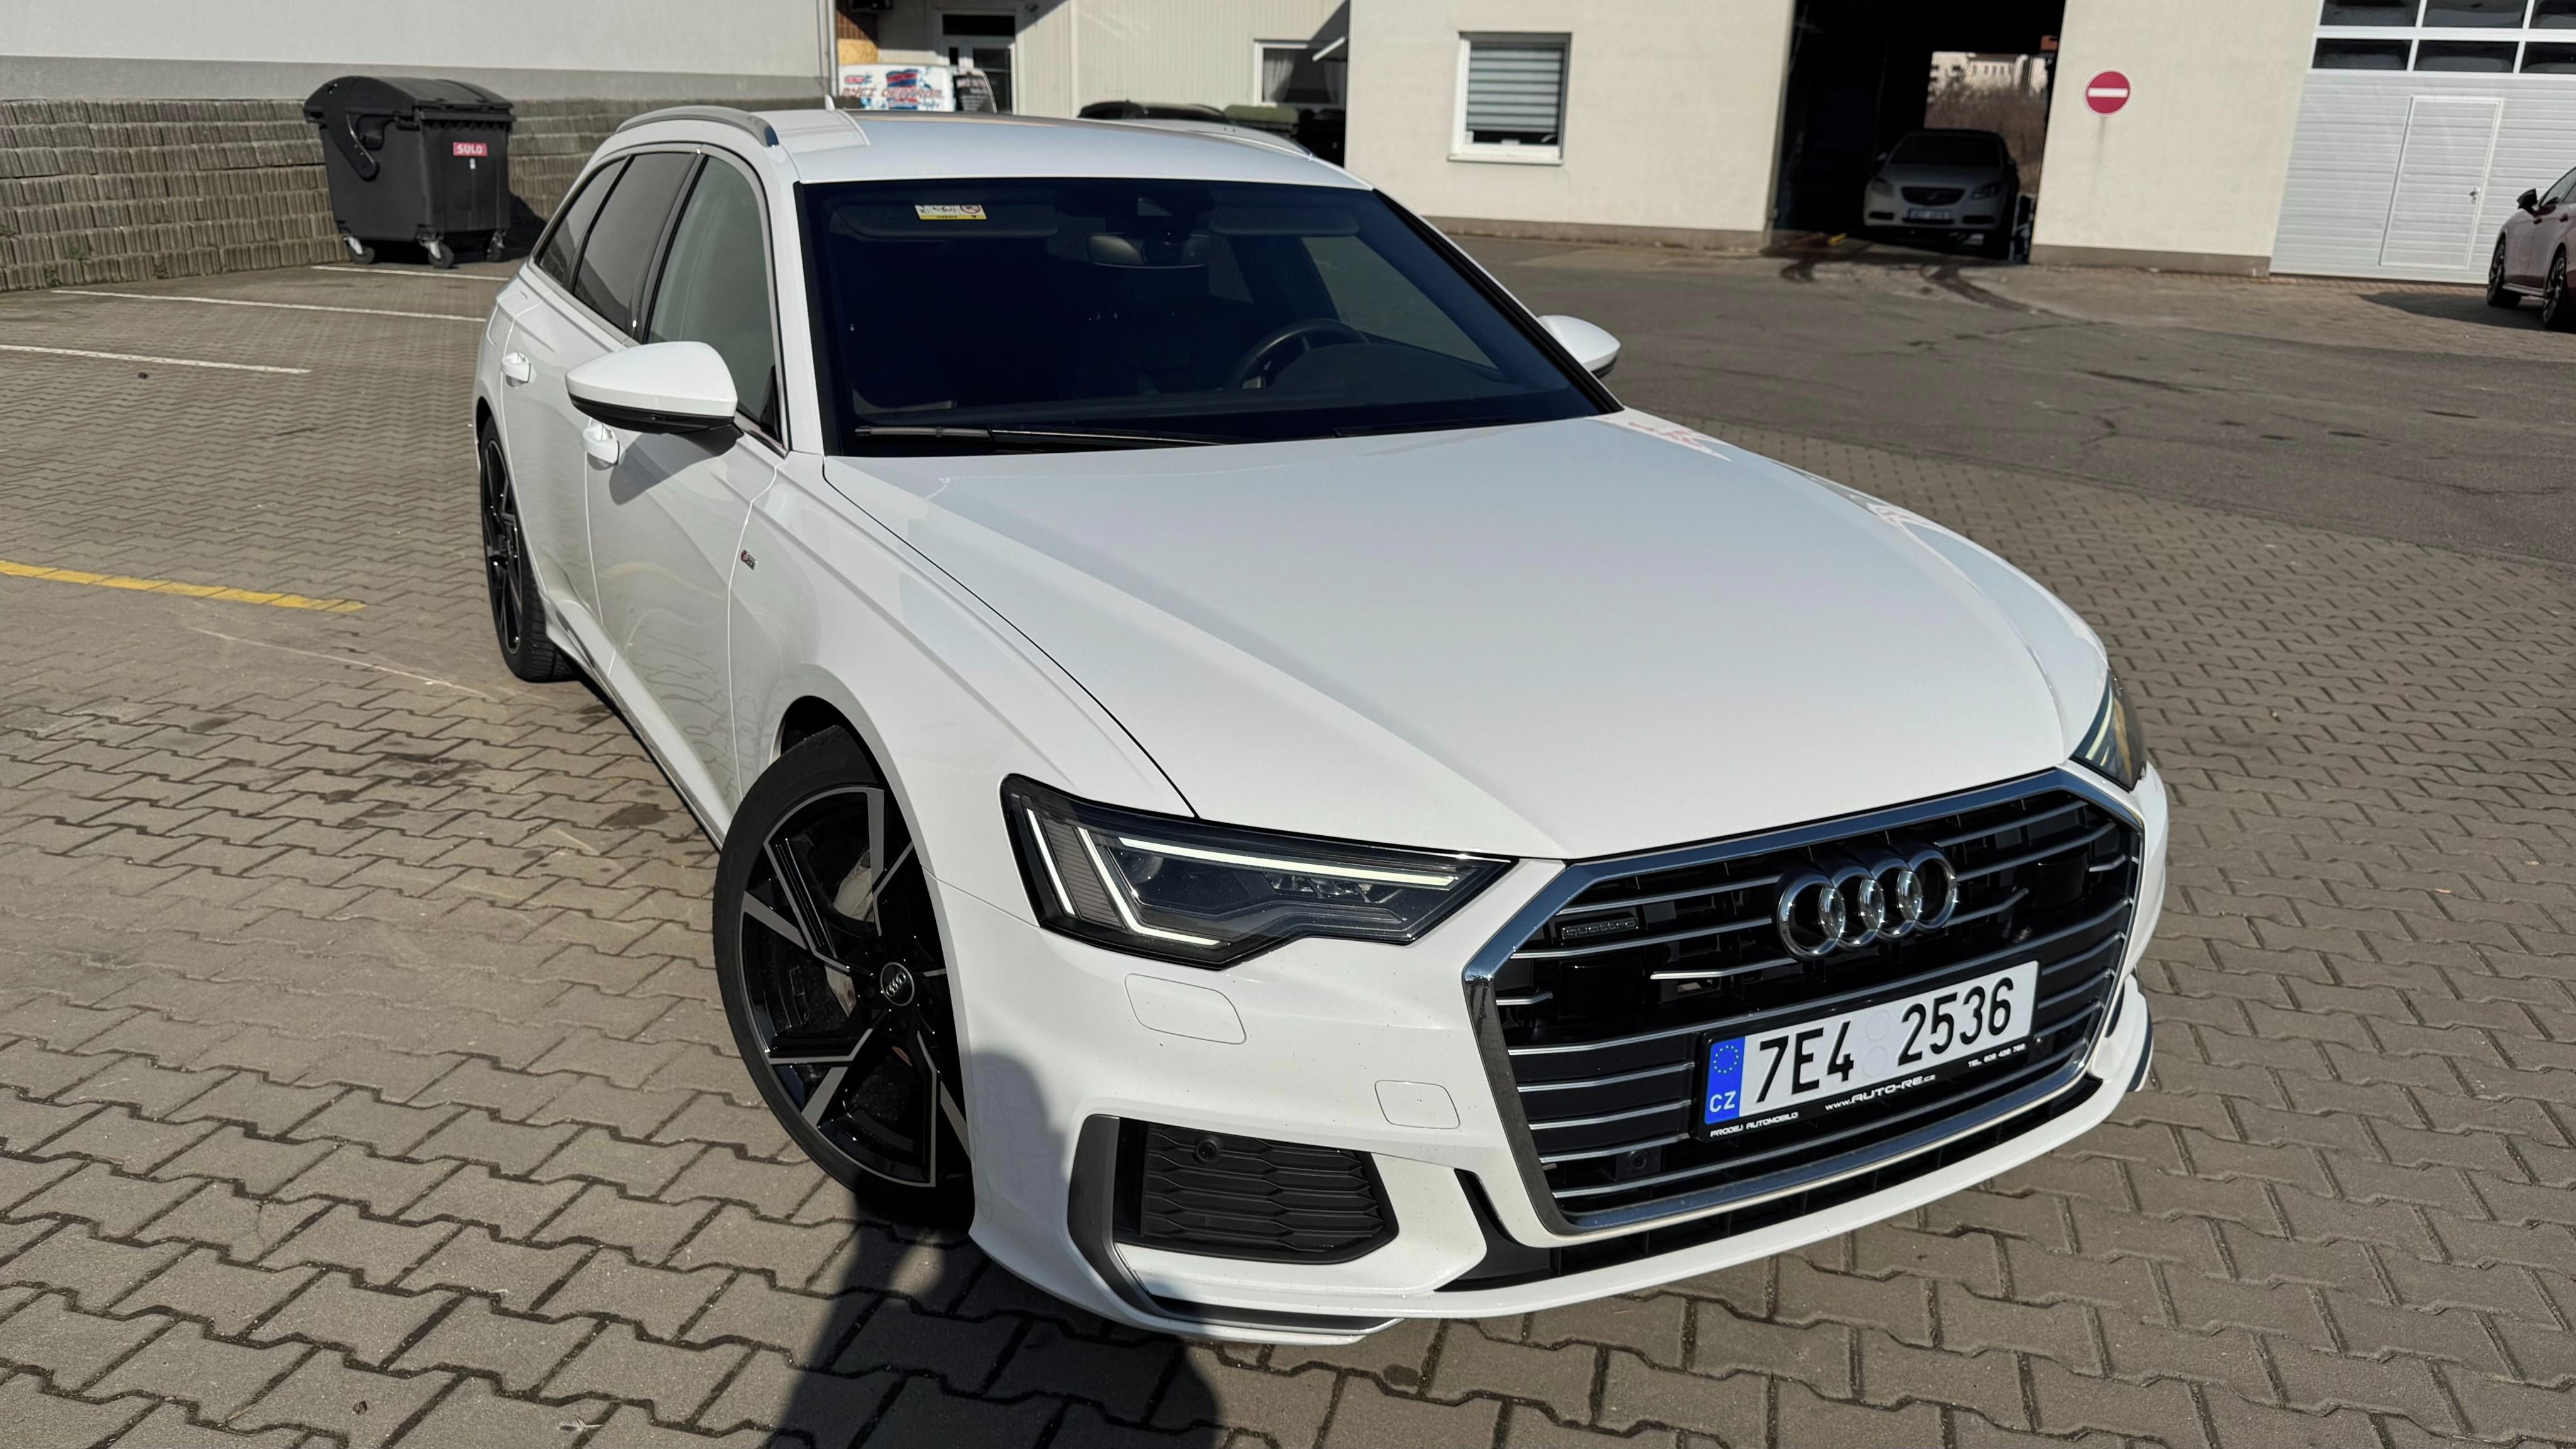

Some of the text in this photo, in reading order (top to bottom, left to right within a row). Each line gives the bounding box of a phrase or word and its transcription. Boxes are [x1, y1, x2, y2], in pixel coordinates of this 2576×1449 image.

[457, 144, 483, 155] SULO
[1567, 920, 1635, 936] quattro
[1755, 976, 2014, 1104] 7E4 2536
[1709, 1090, 1736, 1113] CZ
